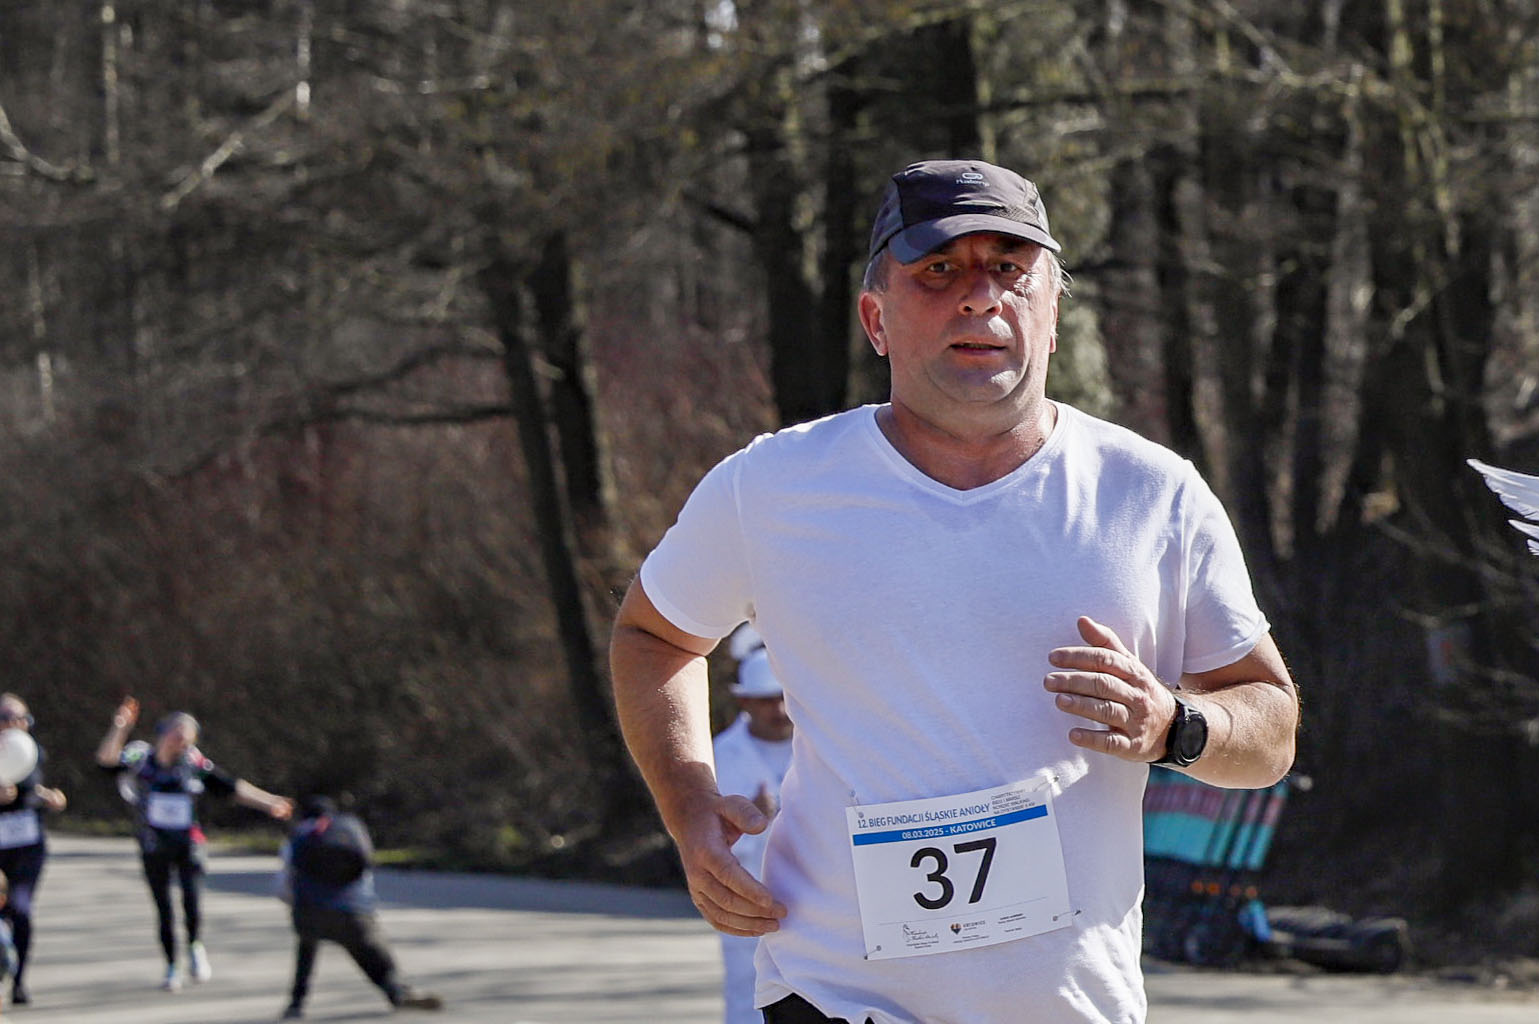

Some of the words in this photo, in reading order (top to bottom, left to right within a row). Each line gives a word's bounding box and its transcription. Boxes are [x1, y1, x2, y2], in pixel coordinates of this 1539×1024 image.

[857, 819, 870, 829] 12.
[870, 817, 887, 828] BIEG
[887, 812, 924, 826] FUNDACJI
[925, 808, 958, 824] ŚLĄSKIE
[959, 803, 990, 819] ANIOŁY
[902, 826, 944, 840] 08.03.2025
[950, 818, 997, 835] KATOWICE
[910, 837, 997, 910] 37
